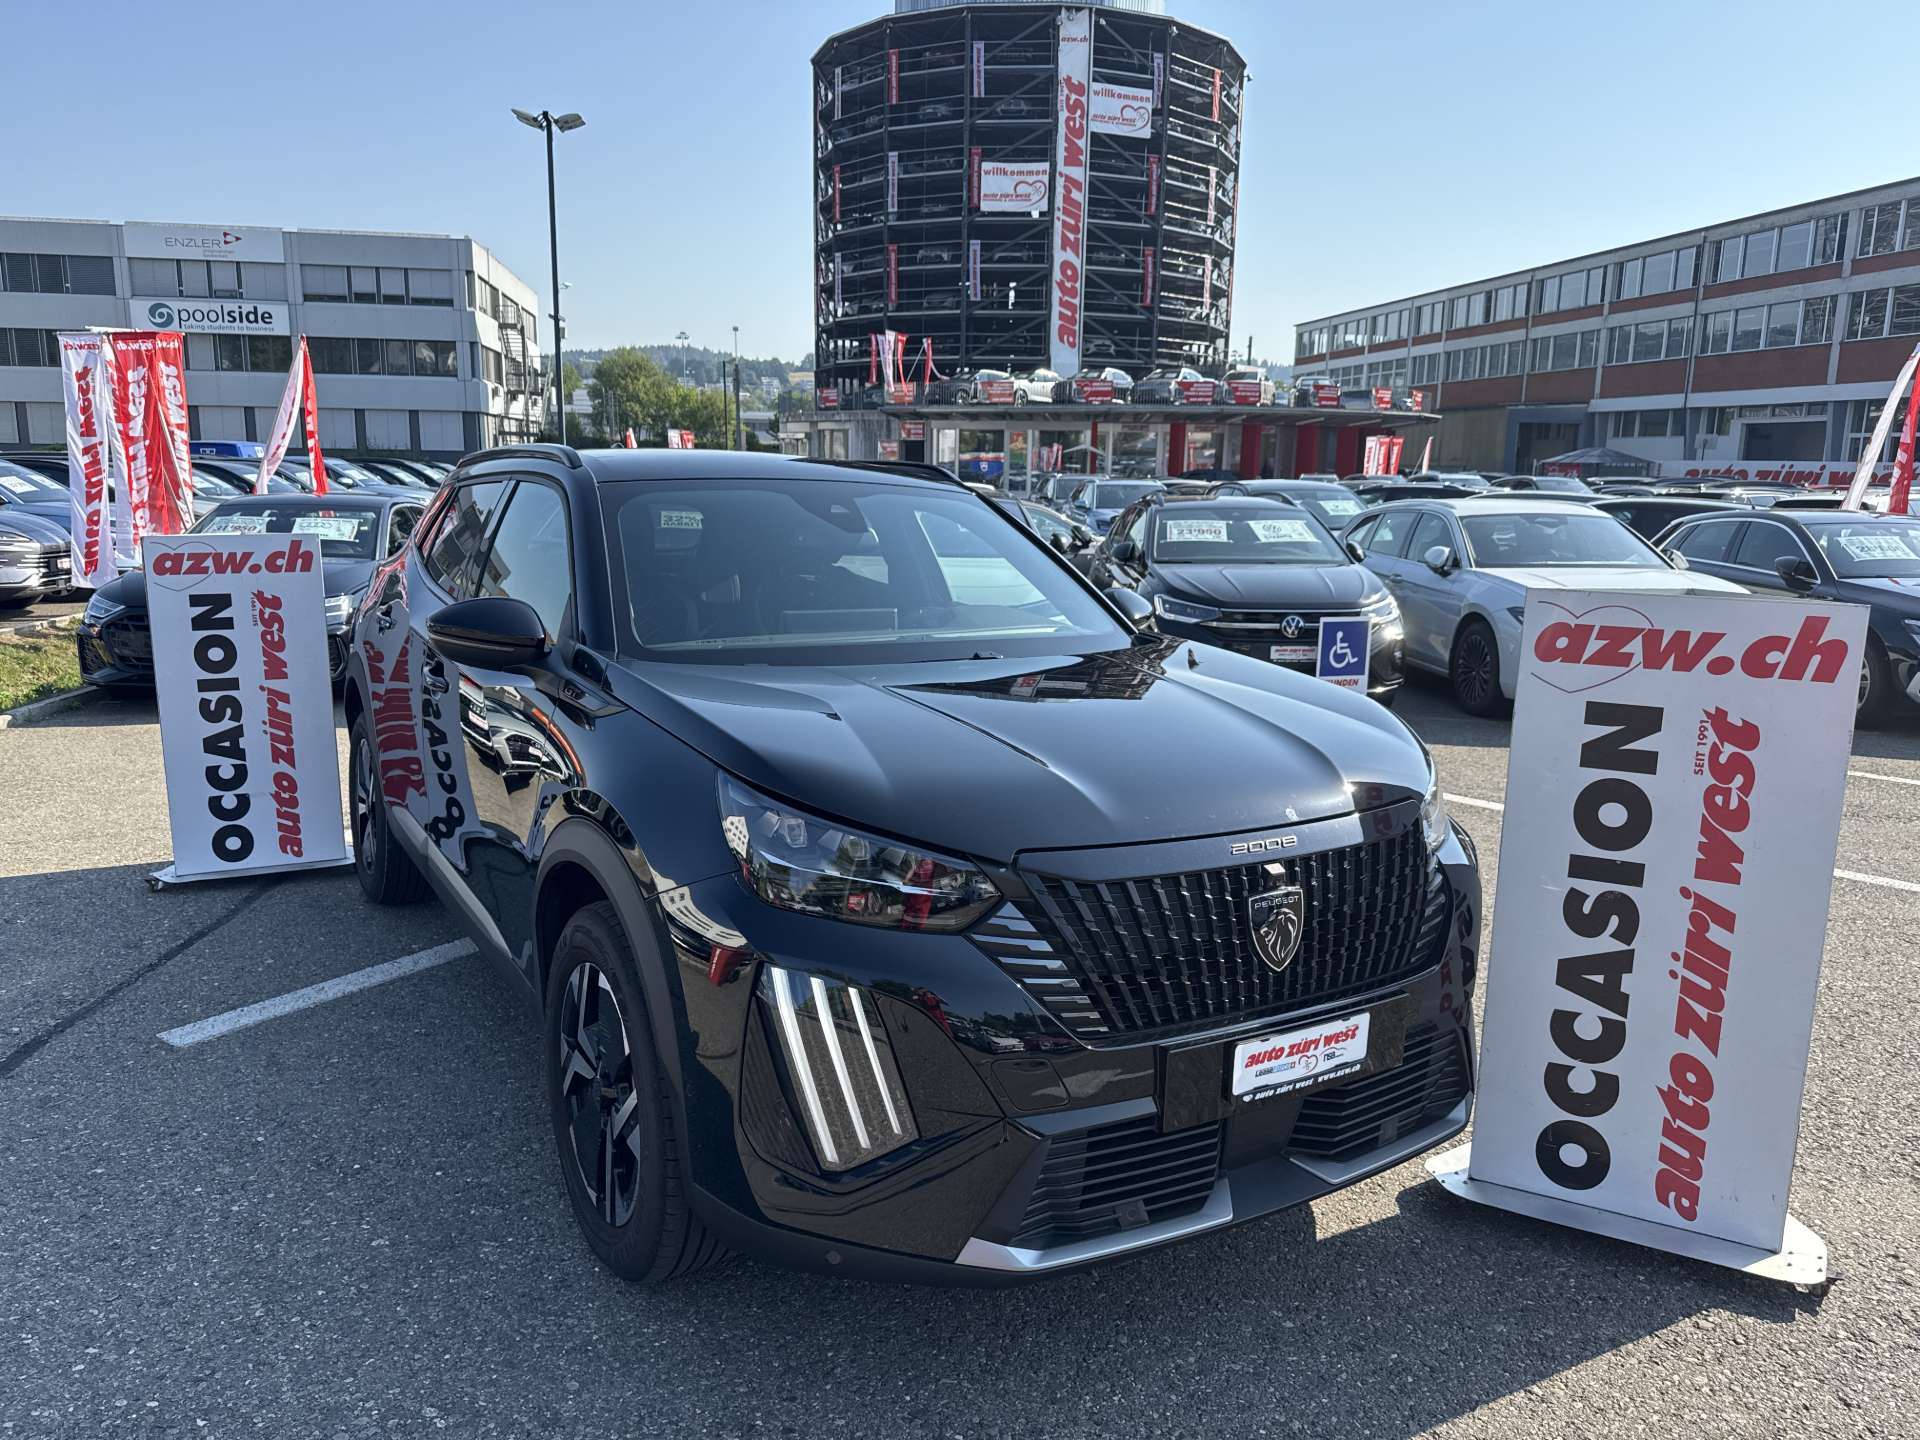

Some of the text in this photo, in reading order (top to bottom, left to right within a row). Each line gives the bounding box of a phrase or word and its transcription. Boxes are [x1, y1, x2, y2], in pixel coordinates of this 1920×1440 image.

[1060, 34, 1089, 44] azw.ch
[1093, 87, 1151, 103] willkommen
[983, 166, 1048, 177] willkommen
[1055, 75, 1087, 350] auto züri west
[164, 236, 221, 249] ENZLER
[177, 304, 273, 329] poolside
[157, 360, 187, 425] west
[152, 540, 313, 576] azw.ch
[251, 610, 259, 627] SEIT
[1533, 616, 1849, 684] azw.ch
[188, 592, 255, 863] OCCASION
[252, 589, 304, 858] auto züri west
[1693, 717, 1710, 777] SEIT 1991
[1231, 835, 1298, 855] 2008
[1254, 895, 1300, 909] PEUGEOT
[1535, 701, 1664, 1191] OCCASION
[1654, 706, 1761, 1222] auto züri west
[1244, 1024, 1359, 1069] auto züri west
[1254, 1088, 1275, 1100] auto
[1275, 1082, 1293, 1095] züri
[1295, 1078, 1314, 1089] west
